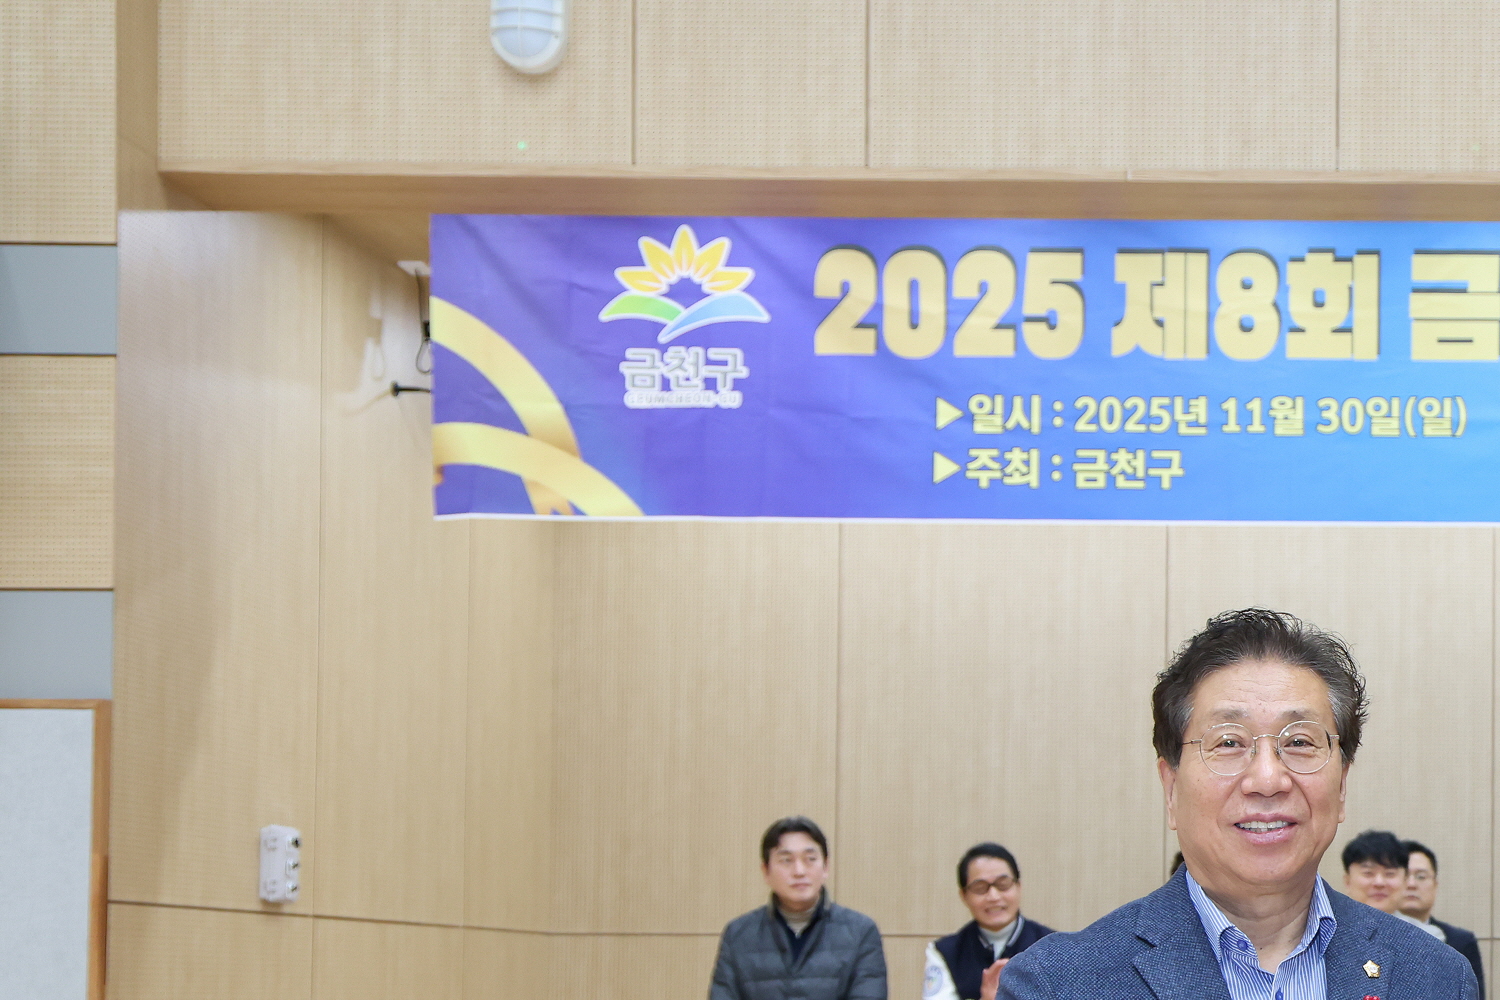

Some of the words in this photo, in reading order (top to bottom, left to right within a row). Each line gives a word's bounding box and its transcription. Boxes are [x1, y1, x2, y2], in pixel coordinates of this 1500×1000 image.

[814, 244, 1085, 360] 2025
[1111, 247, 1381, 361] 제8회
[619, 346, 749, 391] 금천구
[967, 394, 1042, 435] 일시
[1073, 395, 1208, 436] 2025년
[1220, 395, 1305, 437] 11월
[1316, 396, 1468, 438] 30일(일)
[964, 446, 1041, 490] 주최
[1072, 447, 1186, 490] 금천구
